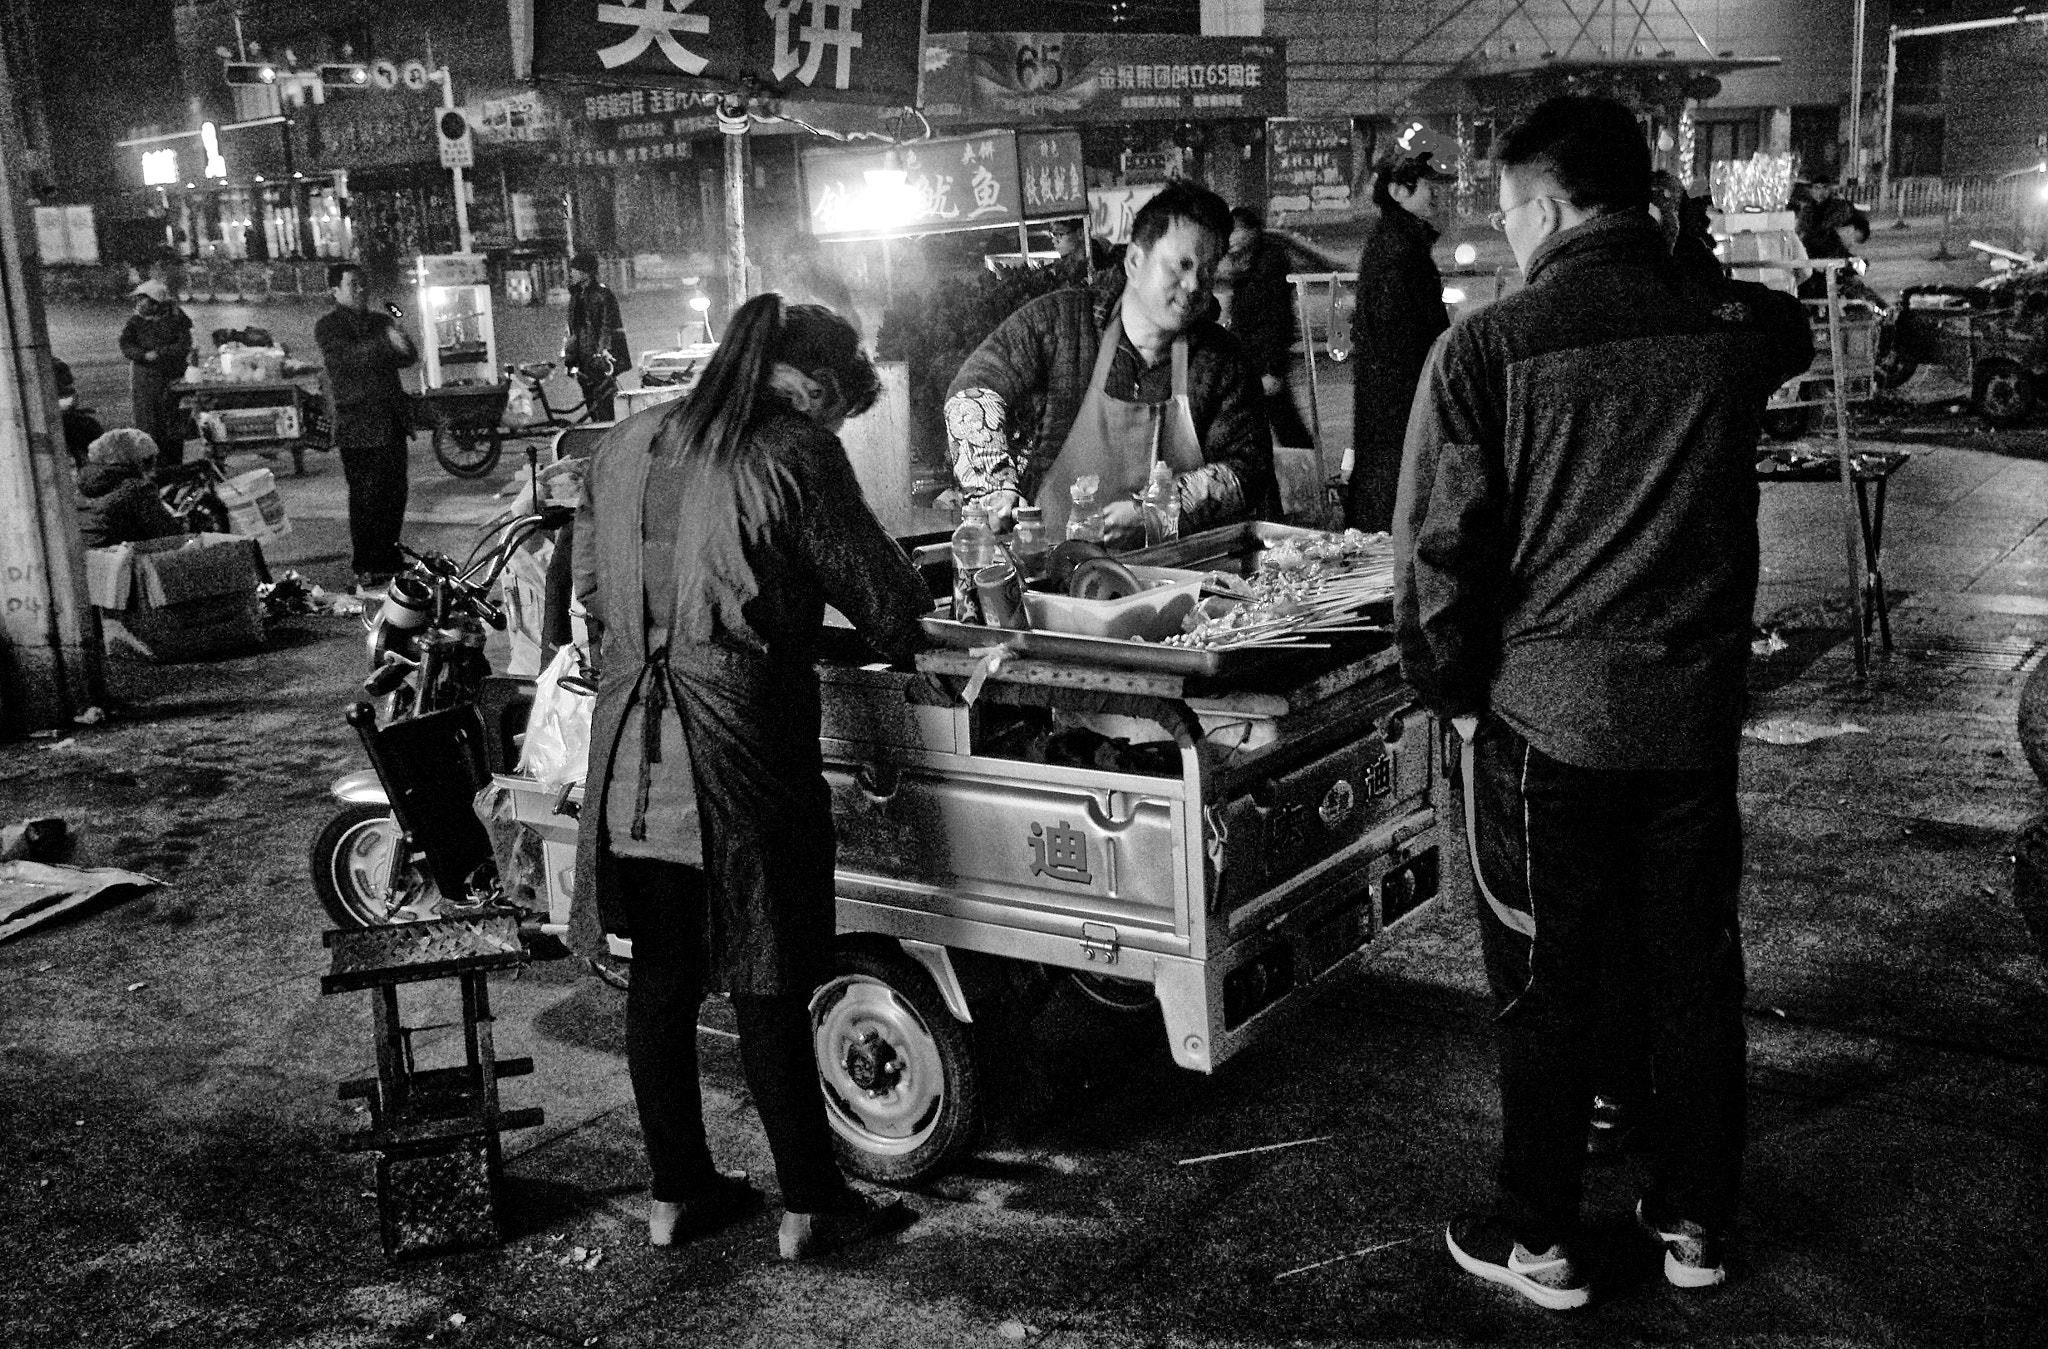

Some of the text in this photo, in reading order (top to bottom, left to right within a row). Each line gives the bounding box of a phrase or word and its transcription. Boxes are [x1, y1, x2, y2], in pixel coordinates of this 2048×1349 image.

[597, 0, 863, 90] 夹饼
[1016, 44, 1063, 91] 65
[1364, 753, 1391, 803] 迪
[1027, 820, 1092, 885] 迪
